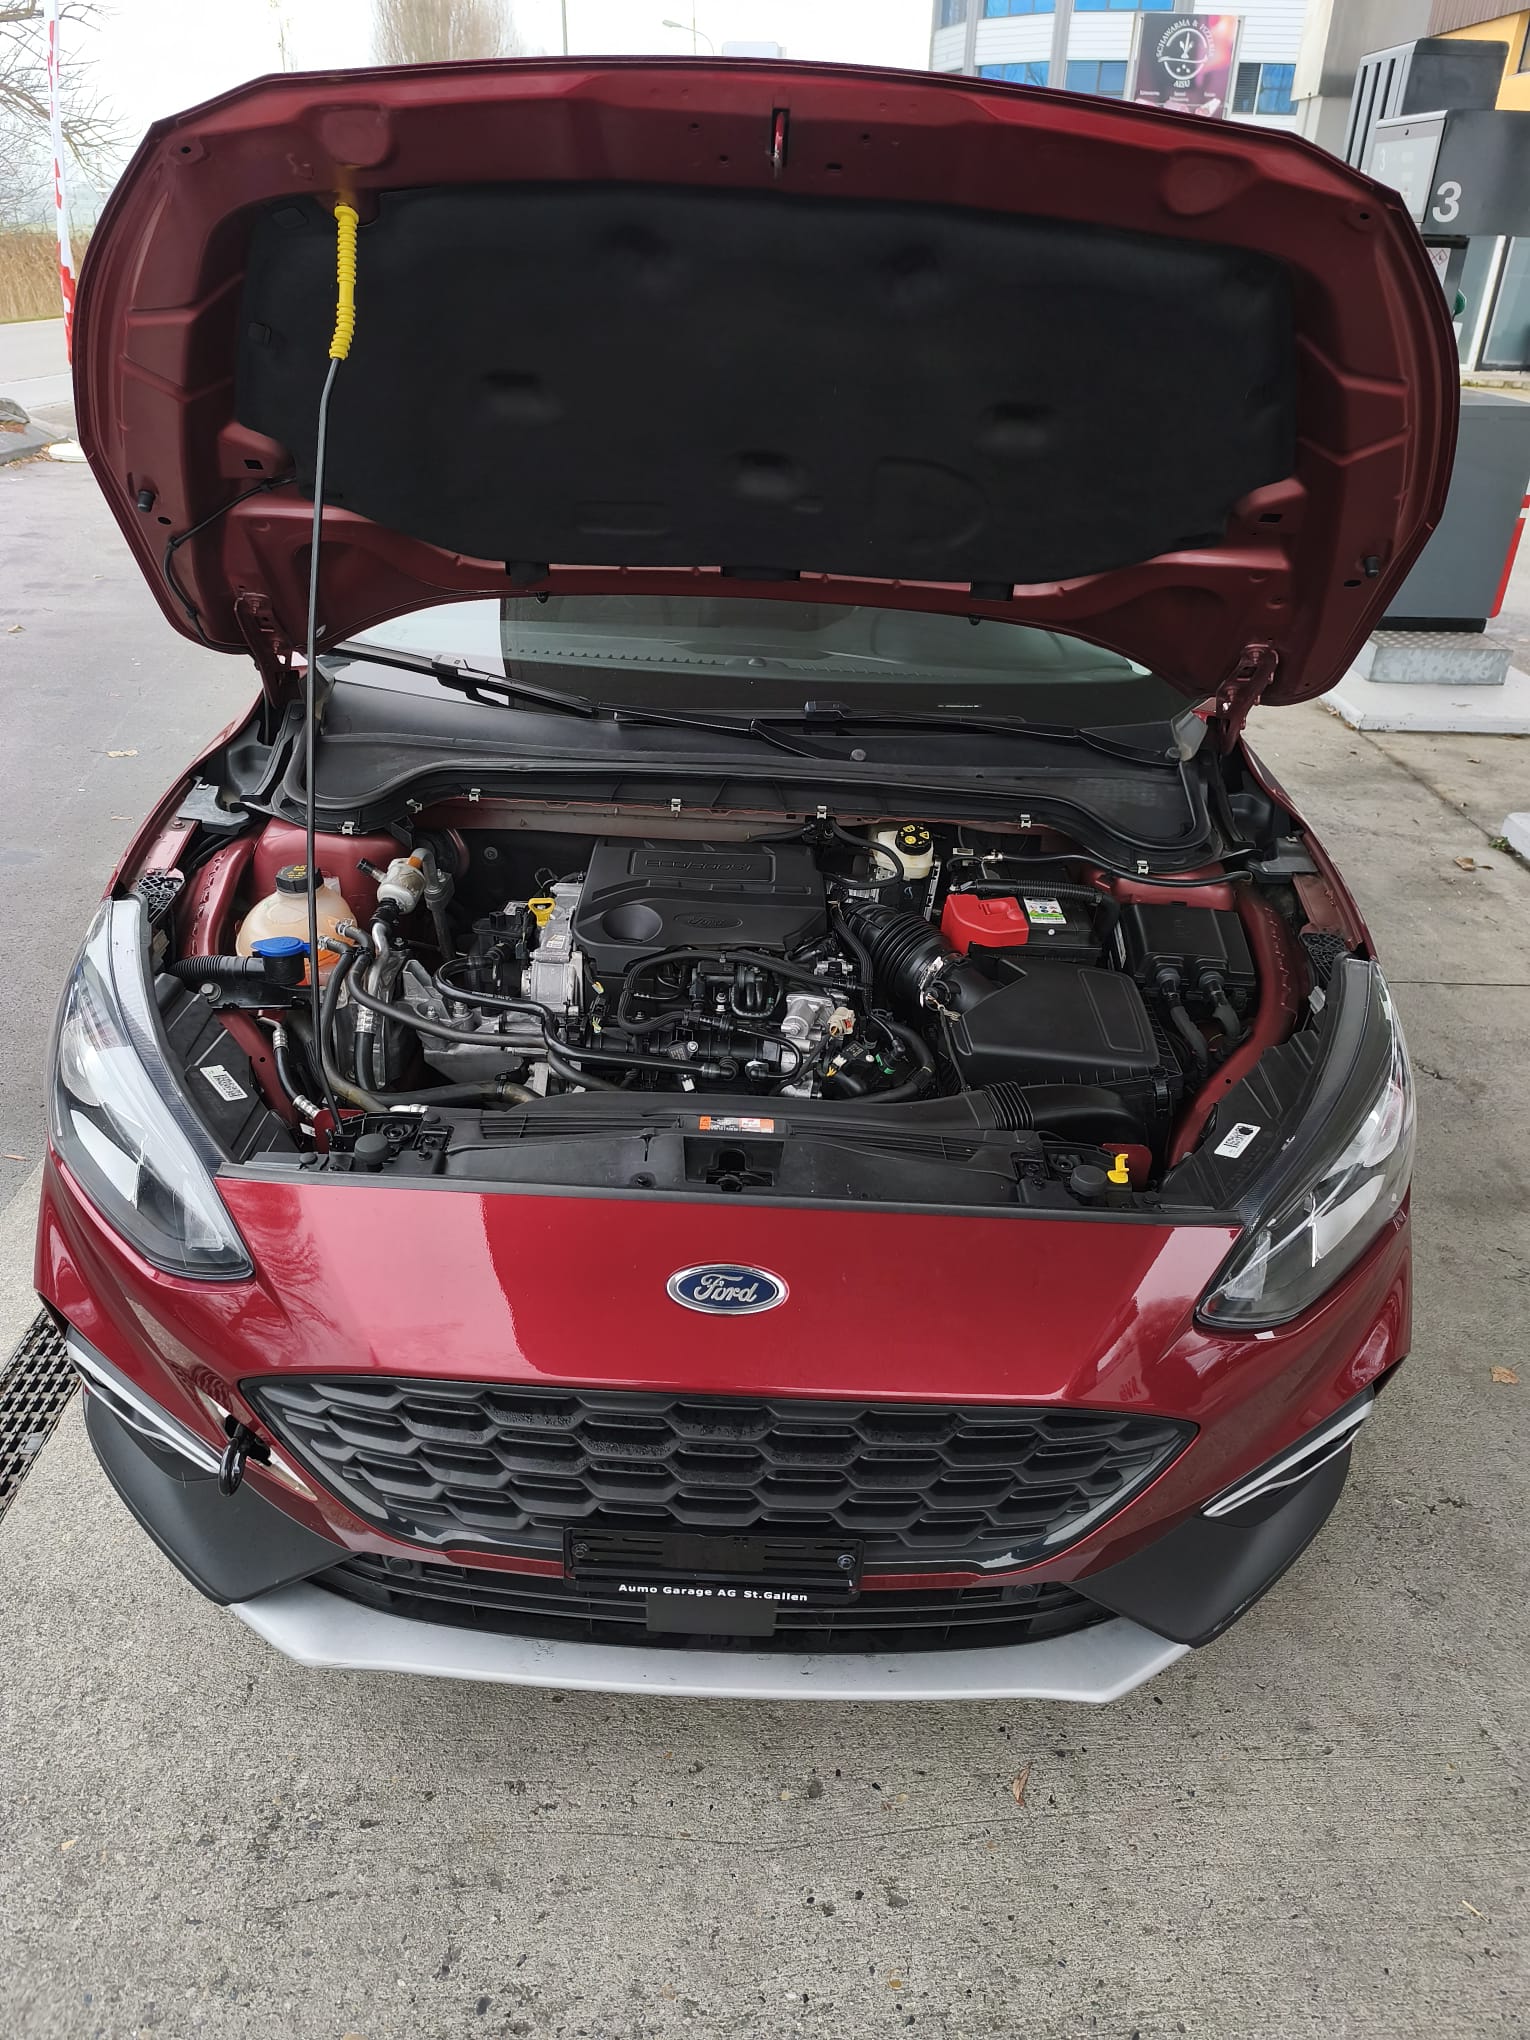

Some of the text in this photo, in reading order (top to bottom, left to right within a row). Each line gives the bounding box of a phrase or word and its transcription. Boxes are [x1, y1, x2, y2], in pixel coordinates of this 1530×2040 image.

[1432, 180, 1462, 223] 3
[693, 1273, 758, 1303] Ford
[618, 1584, 808, 1602] Aumo Garage AG St.Gallen
